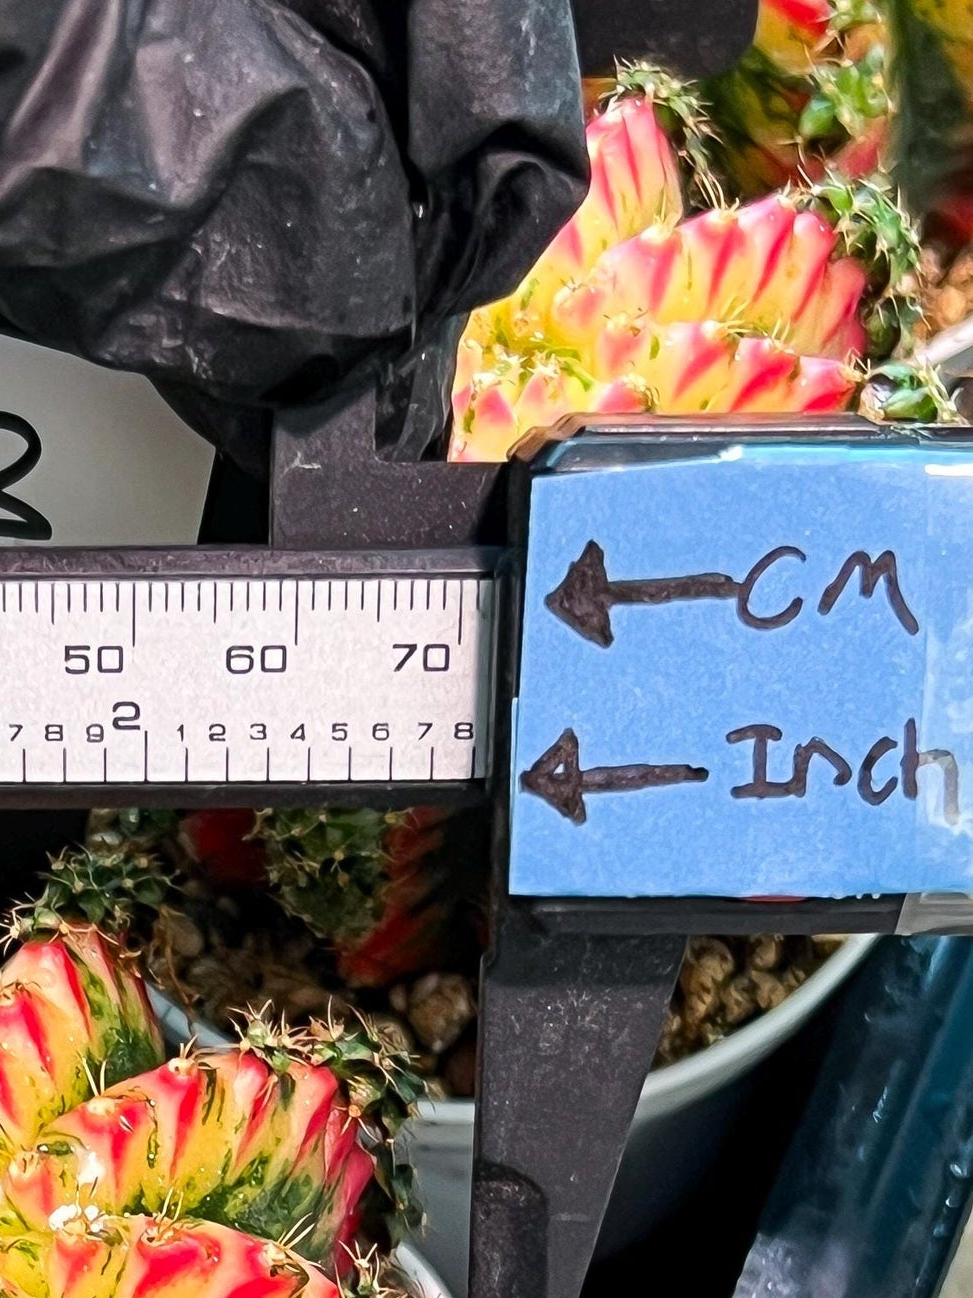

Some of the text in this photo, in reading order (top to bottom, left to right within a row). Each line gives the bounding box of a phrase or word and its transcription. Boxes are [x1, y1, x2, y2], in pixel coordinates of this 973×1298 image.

[64, 644, 125, 675] 50
[225, 644, 288, 675] 60
[392, 642, 451, 673] 70
[9, 724, 24, 742] 7
[44, 724, 64, 742] 8
[85, 723, 105, 743] 9
[112, 701, 141, 732] 2
[177, 724, 184, 742] 1
[208, 723, 226, 742] 2
[249, 723, 267, 741] 3
[290, 723, 306, 742] 4
[331, 722, 348, 742] 5
[372, 722, 390, 741] 6
[418, 722, 433, 741] 7
[453, 721, 475, 741] 8
[725, 717, 960, 827] Inch
